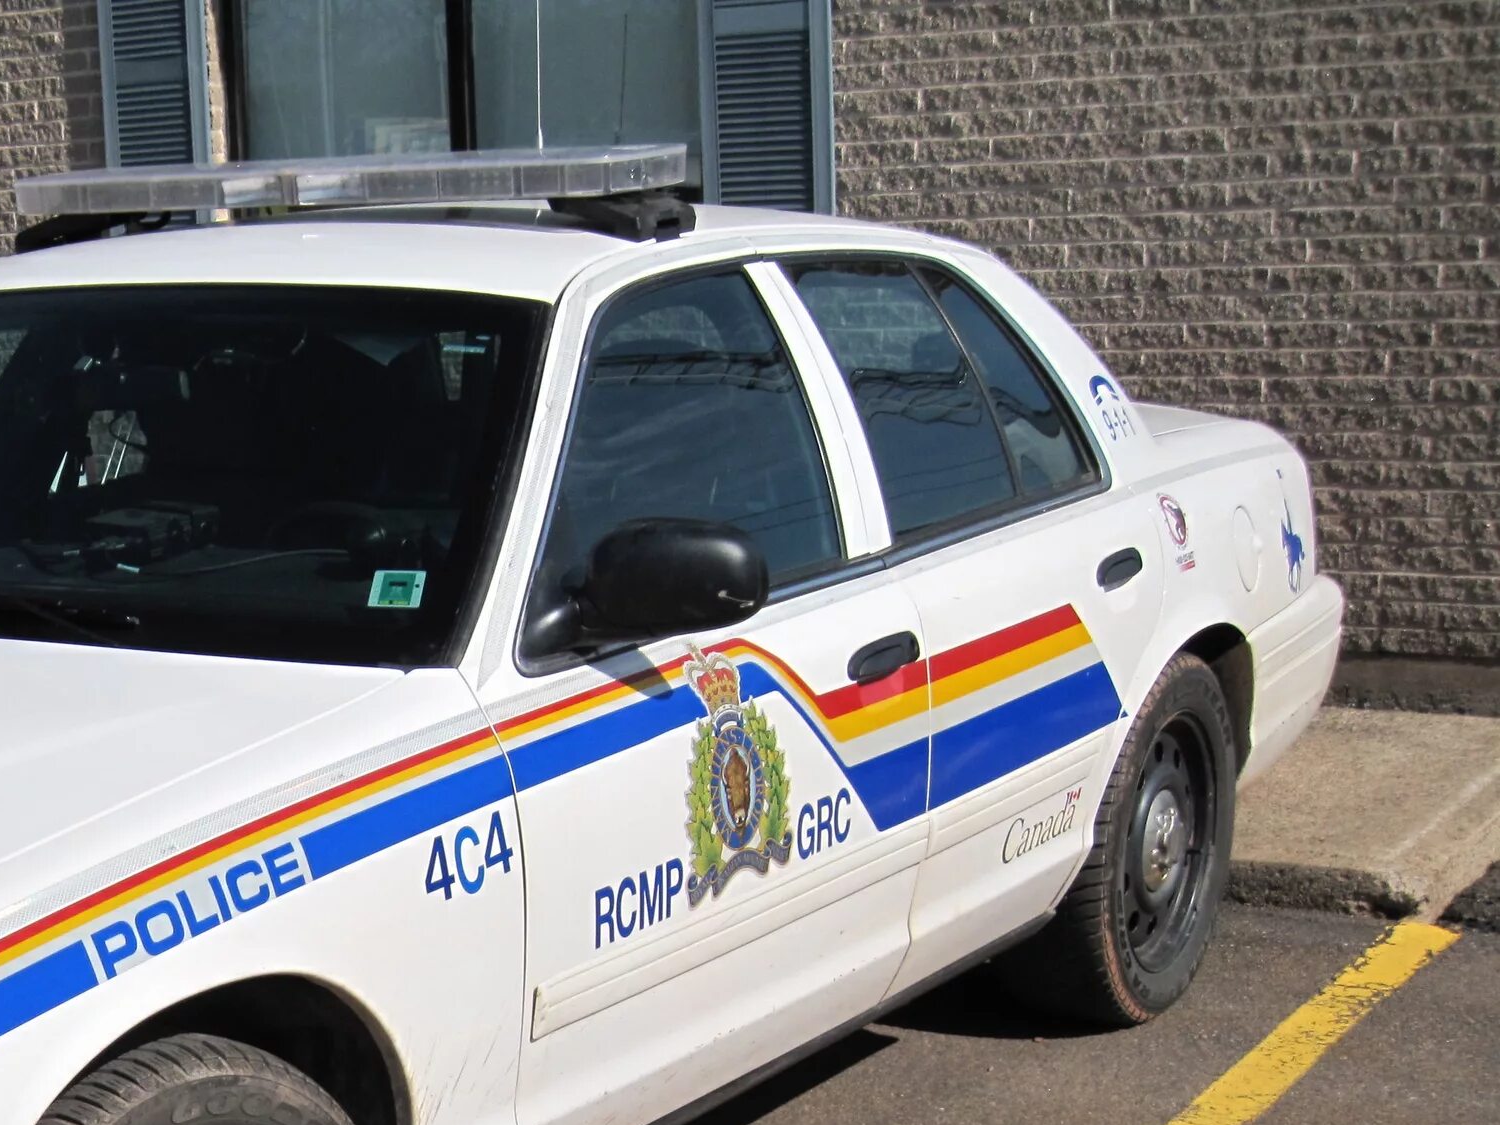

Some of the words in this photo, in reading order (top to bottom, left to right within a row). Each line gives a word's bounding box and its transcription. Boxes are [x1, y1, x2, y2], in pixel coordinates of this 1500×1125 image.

[1102, 407, 1136, 441] 9-1-1
[424, 811, 513, 901] 4C4
[797, 788, 851, 860] GRC
[1002, 792, 1077, 864] Canada
[91, 842, 306, 980] POLICE
[595, 857, 683, 949] RCMP
